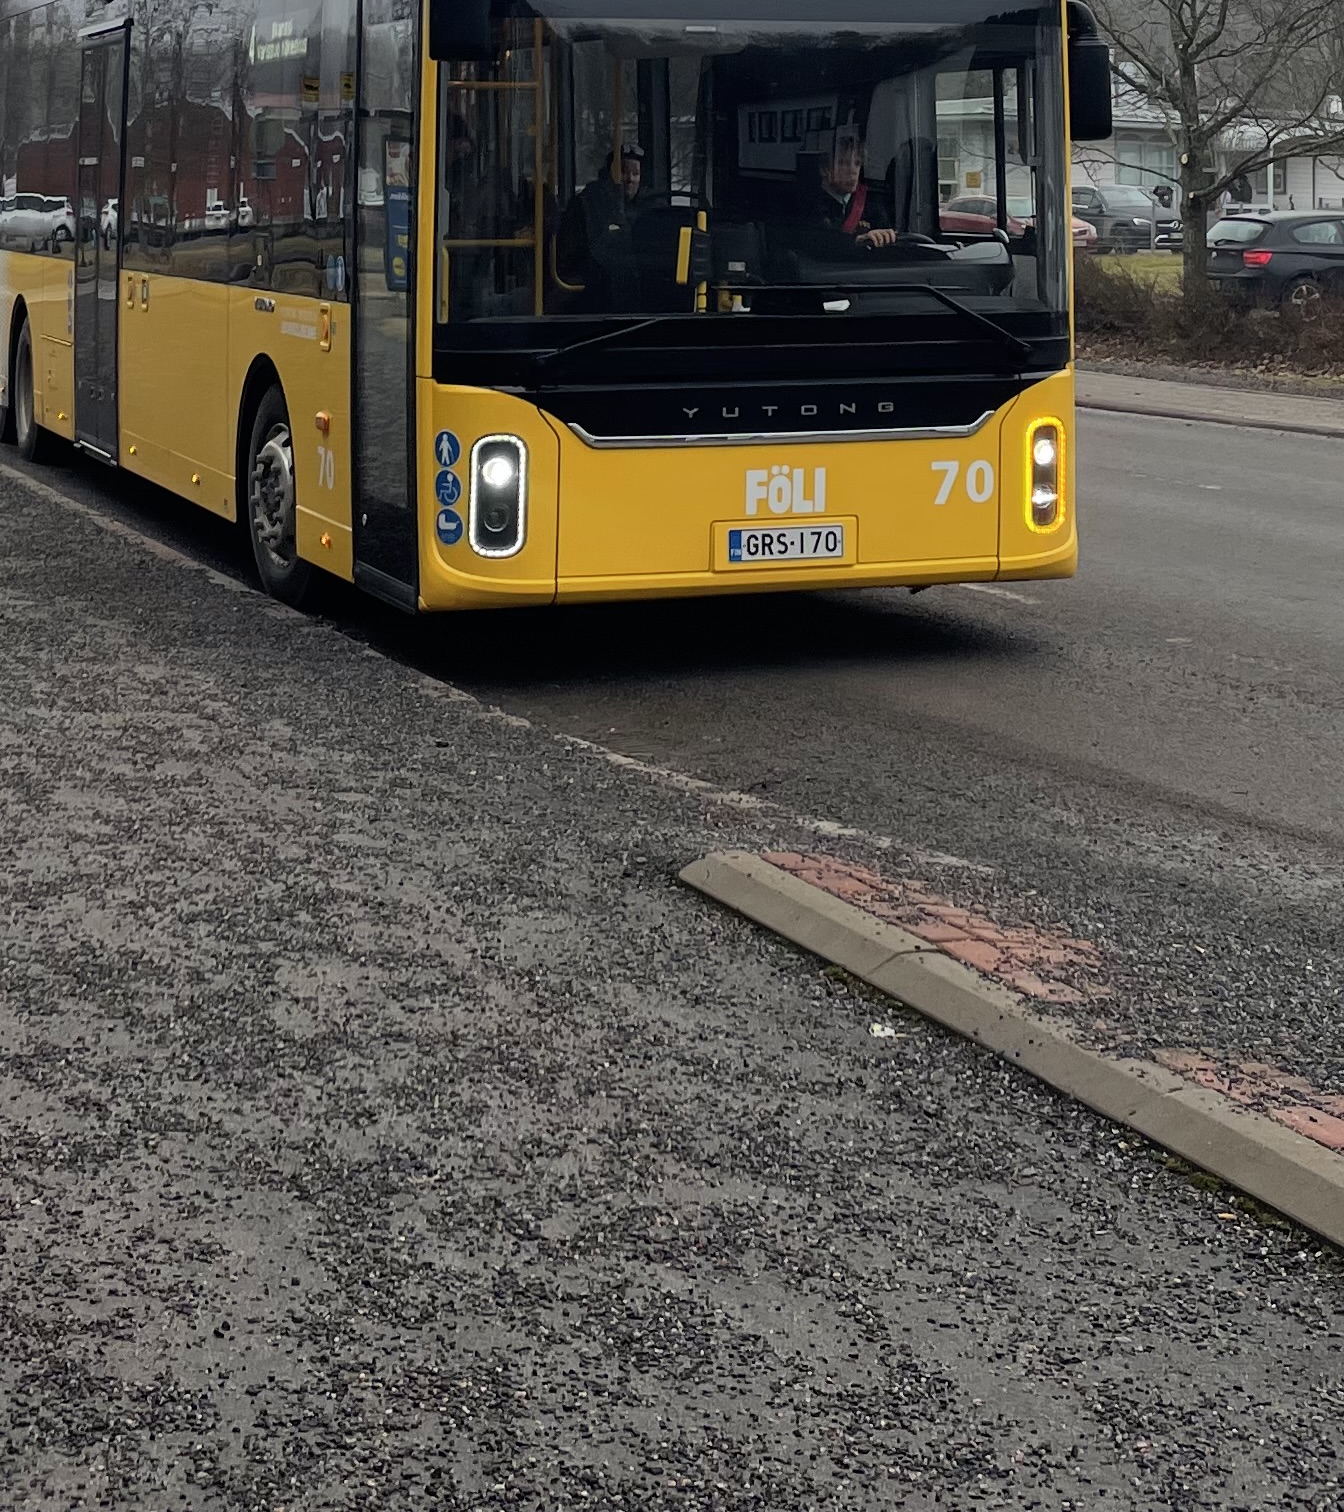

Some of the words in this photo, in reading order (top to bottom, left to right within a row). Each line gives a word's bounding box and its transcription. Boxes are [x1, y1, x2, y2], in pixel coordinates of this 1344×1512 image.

[682, 402, 894, 419] YUTONG
[317, 445, 334, 489] 70
[931, 459, 994, 505] 70
[745, 465, 827, 515] FÖLI
[746, 531, 837, 556] GRS-170
